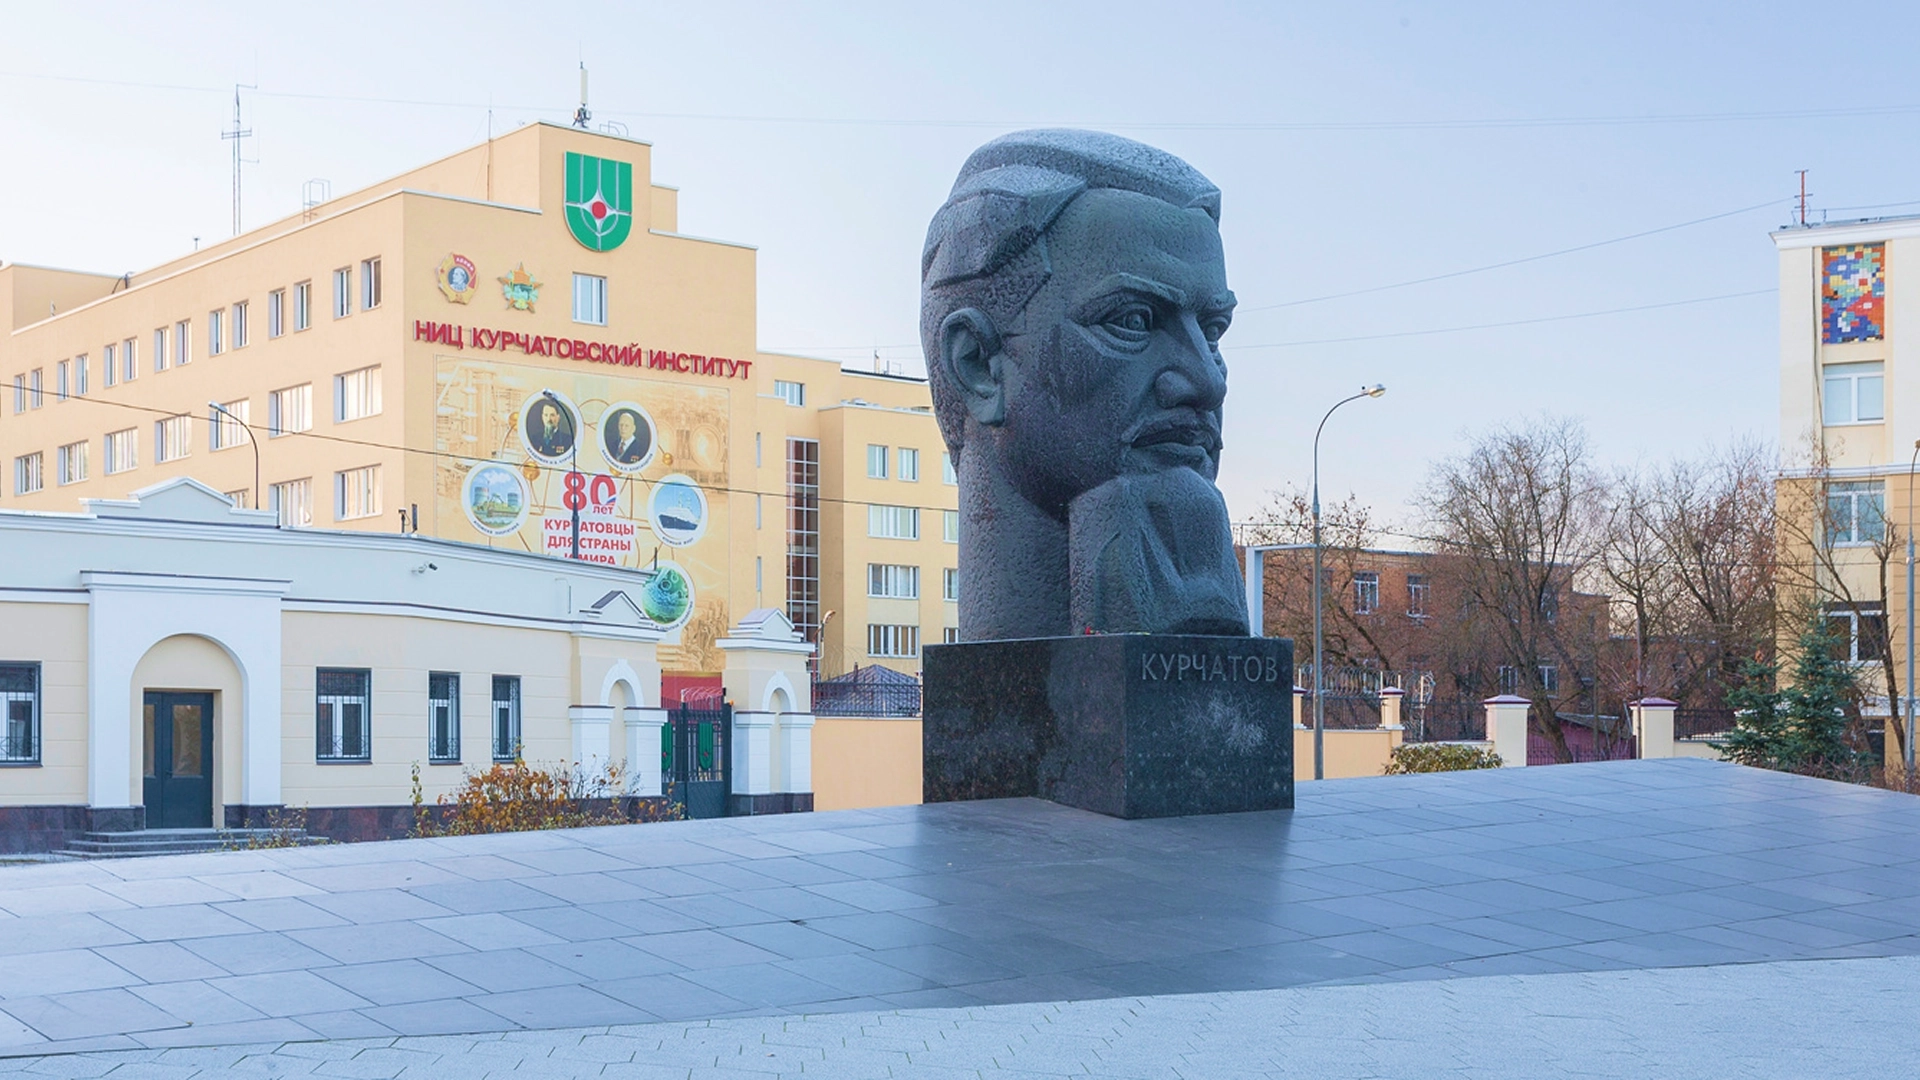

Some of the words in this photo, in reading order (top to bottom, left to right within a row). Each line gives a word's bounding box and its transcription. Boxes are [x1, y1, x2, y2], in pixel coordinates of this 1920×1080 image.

[414, 319, 465, 350] НИЦ
[471, 327, 643, 368] КУРЧАТОВСКИЙ
[648, 349, 753, 380] ИНСТИТУТ
[562, 471, 616, 511] 80
[593, 505, 613, 515] лет
[544, 519, 634, 536] КУРАТОВЦЫ
[578, 537, 631, 551] СТРАНЫ
[1141, 653, 1278, 682] КУРЧАТОВ
